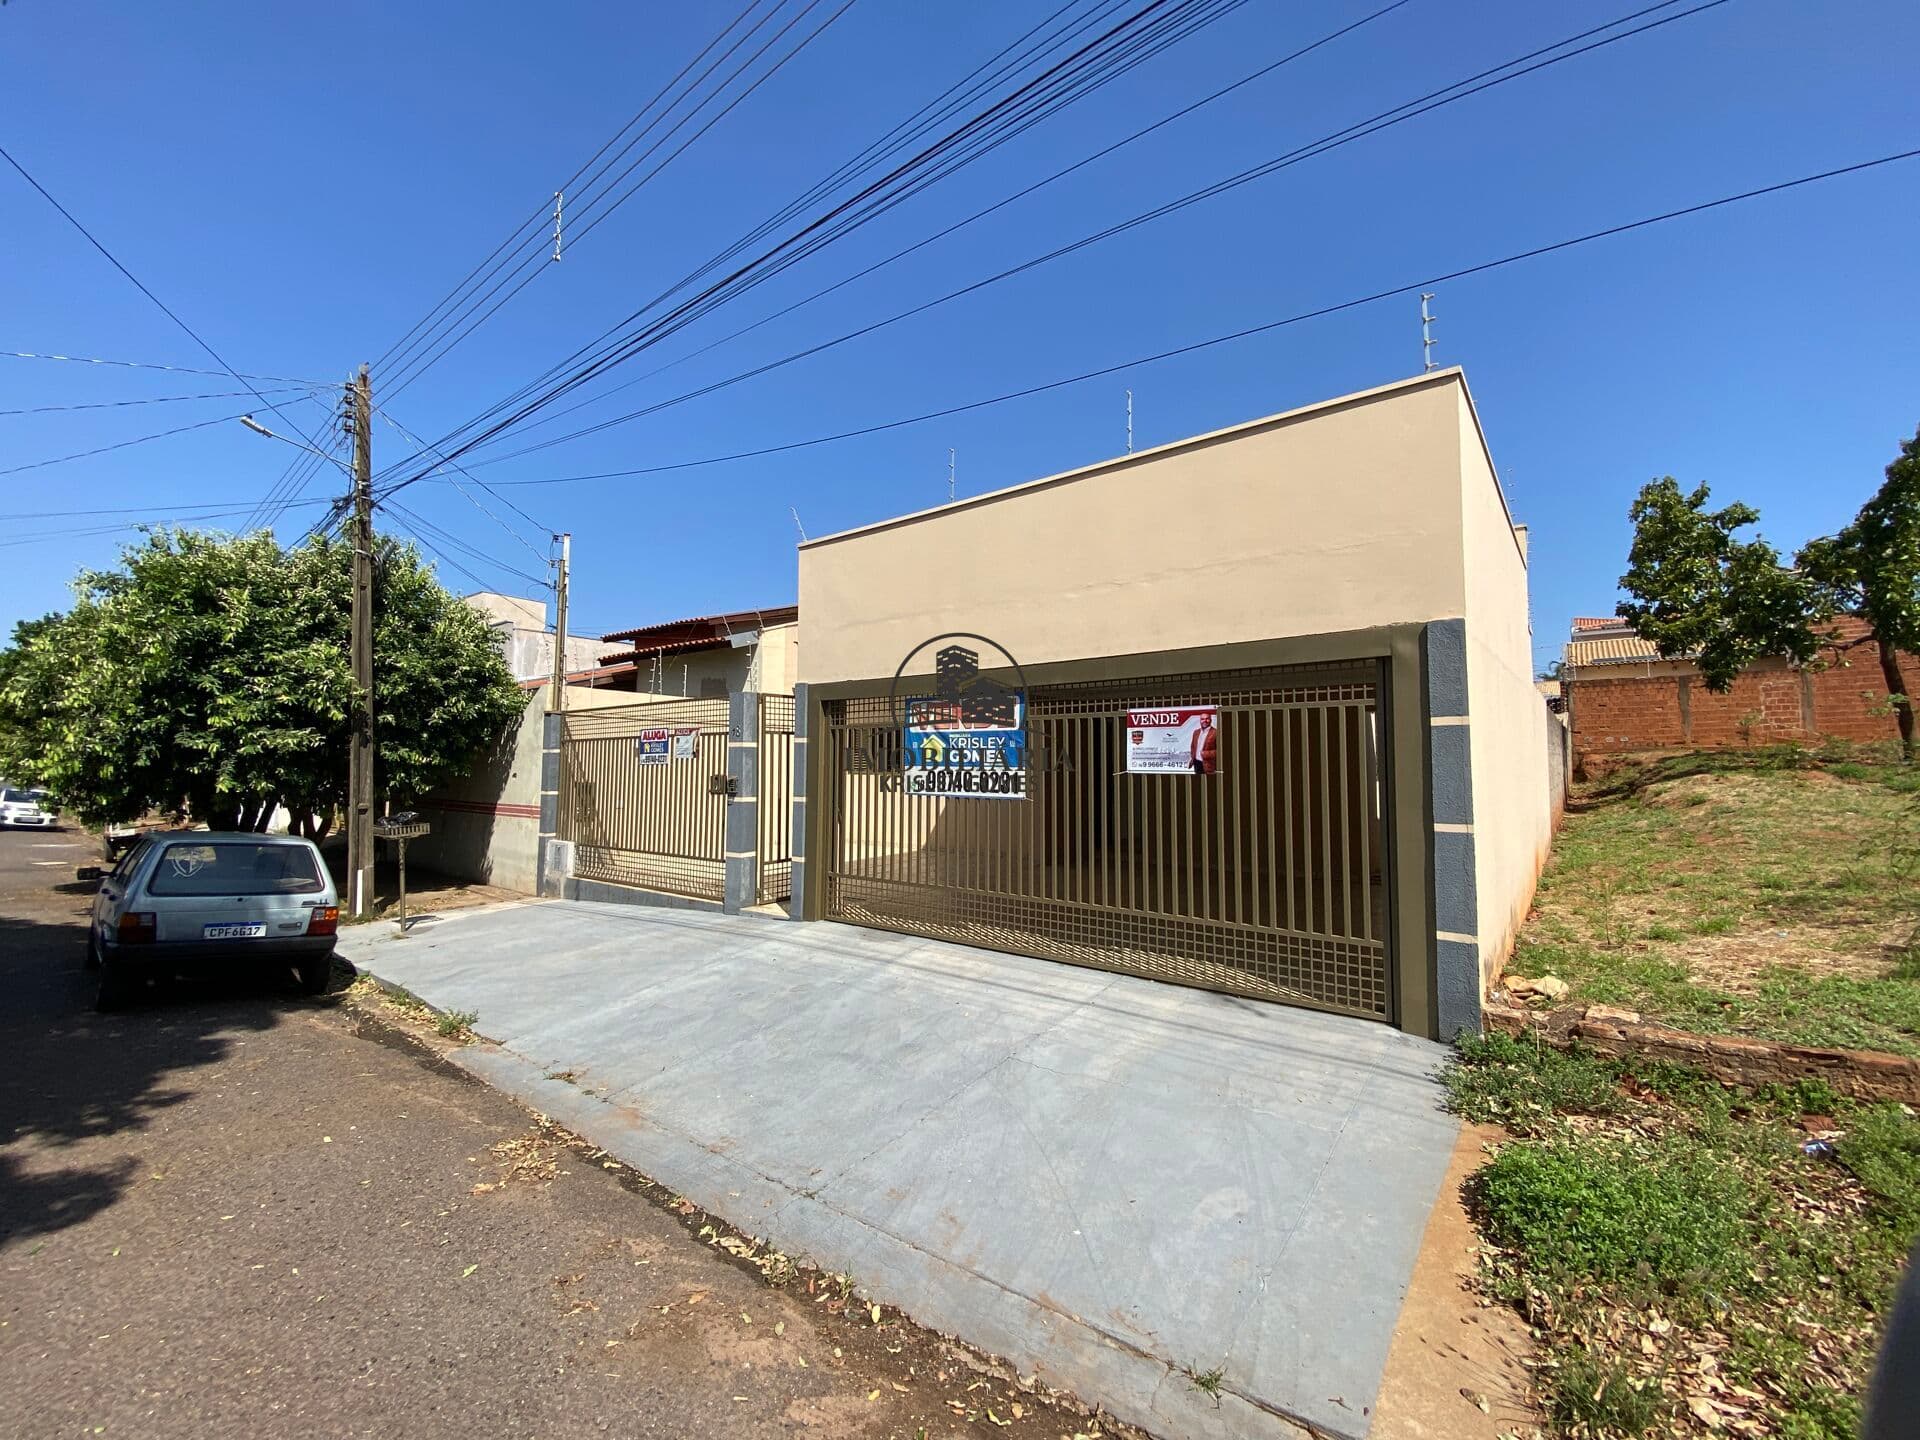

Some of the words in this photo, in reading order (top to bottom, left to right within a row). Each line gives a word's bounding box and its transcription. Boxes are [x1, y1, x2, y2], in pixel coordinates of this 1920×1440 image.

[1131, 713, 1179, 725] VENDE
[643, 730, 666, 741] ALUGA
[949, 737, 1005, 749] KRISLEY
[209, 926, 261, 937] CPF6G17
